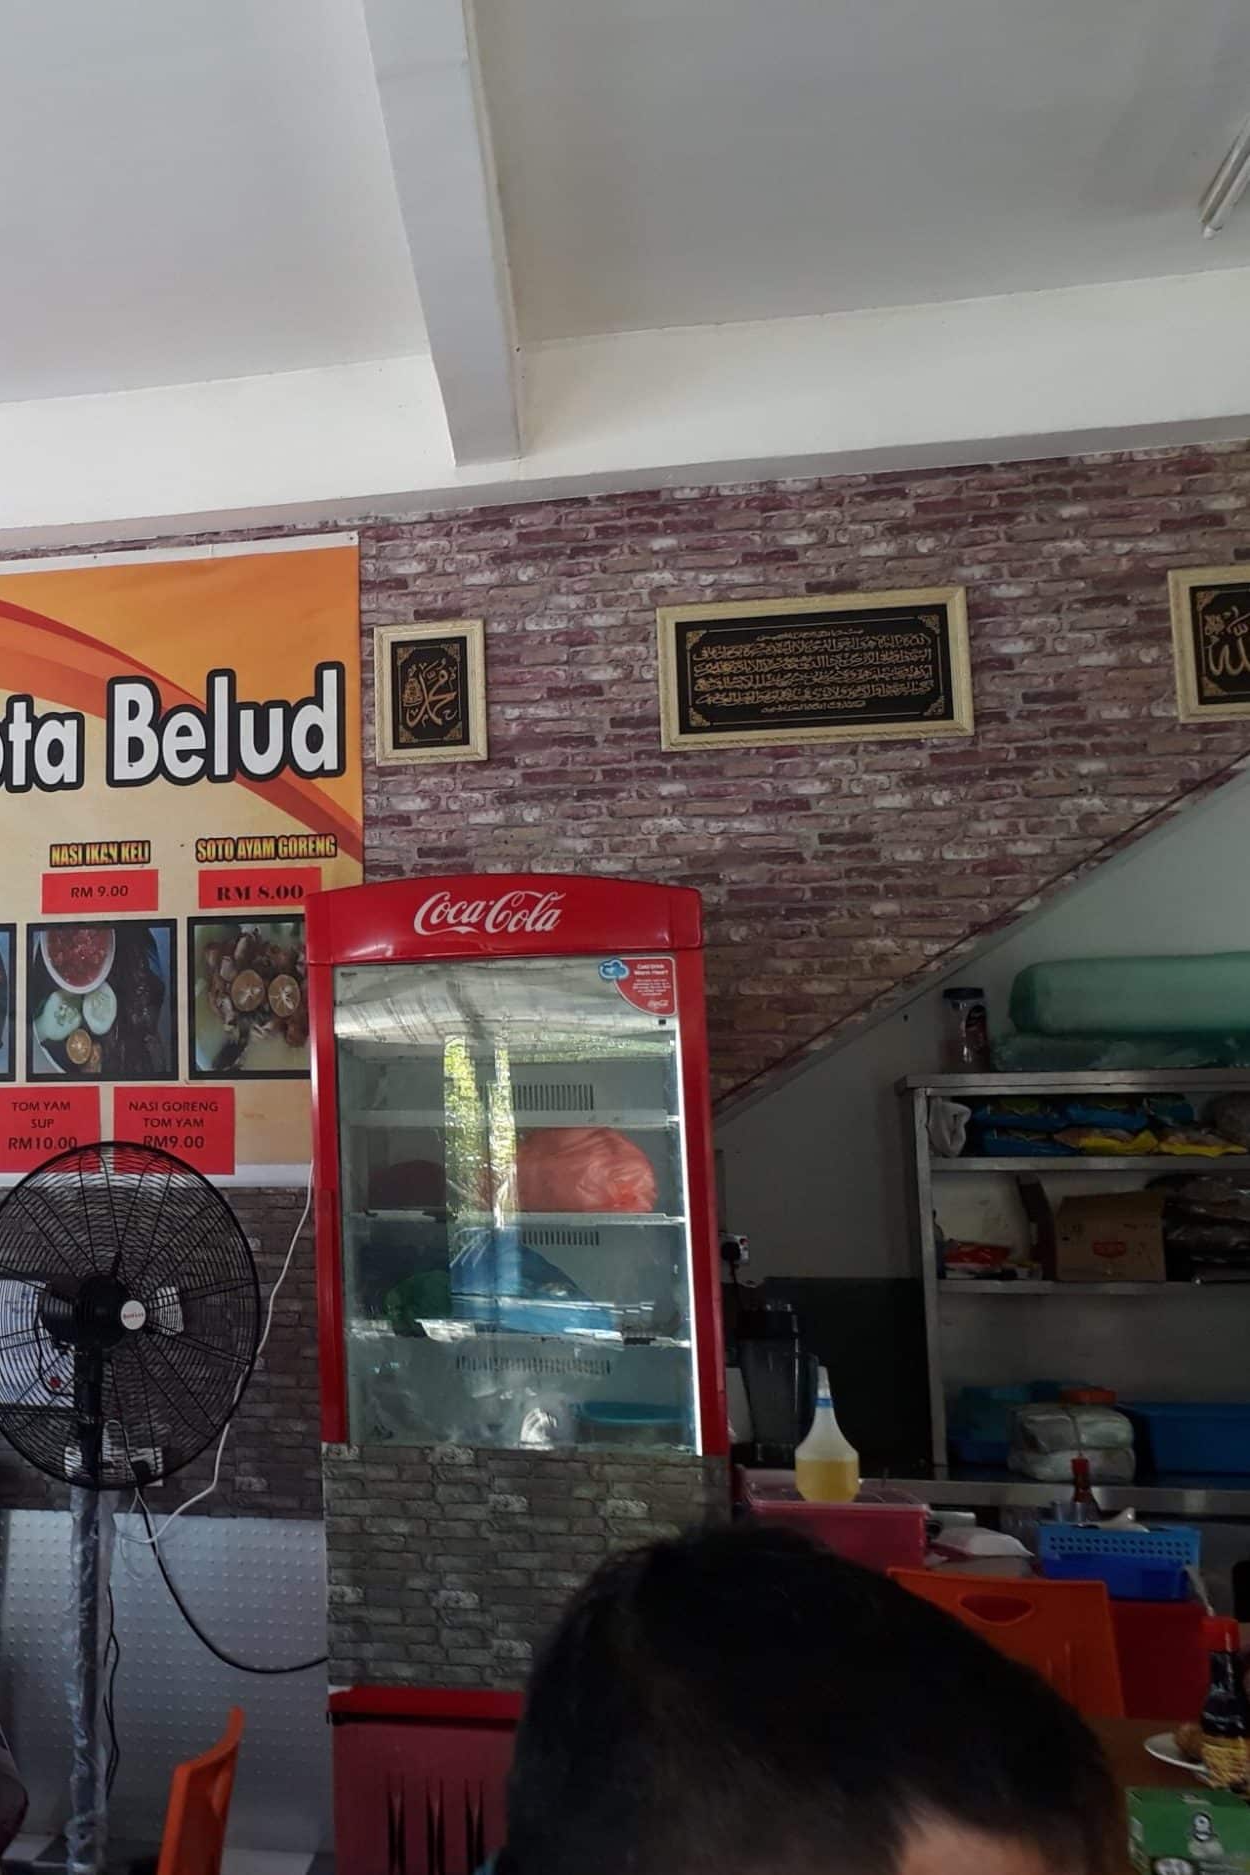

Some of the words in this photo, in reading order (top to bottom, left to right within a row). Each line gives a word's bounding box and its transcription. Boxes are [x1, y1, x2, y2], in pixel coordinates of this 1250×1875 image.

[107, 662, 345, 787] Belud
[50, 844, 83, 867] NASI
[85, 842, 118, 866] IKAN
[120, 840, 150, 864] KELI
[196, 839, 235, 862] SOTO
[236, 837, 276, 861] AYAM
[277, 834, 337, 859] GORENG
[70, 886, 93, 899] RM
[97, 885, 129, 898] 9.00
[217, 885, 251, 901] RM
[258, 884, 304, 900] 8.00
[11, 1101, 41, 1112] TOM
[42, 1100, 71, 1111] YAM
[128, 1101, 159, 1112] NASI
[161, 1101, 219, 1112] GORENG
[30, 1118, 55, 1129] SUP
[142, 1117, 174, 1128] TOM
[174, 1117, 205, 1128] YAM
[8, 1136, 78, 1150] RM10.00
[143, 1135, 205, 1149] RM9.00
